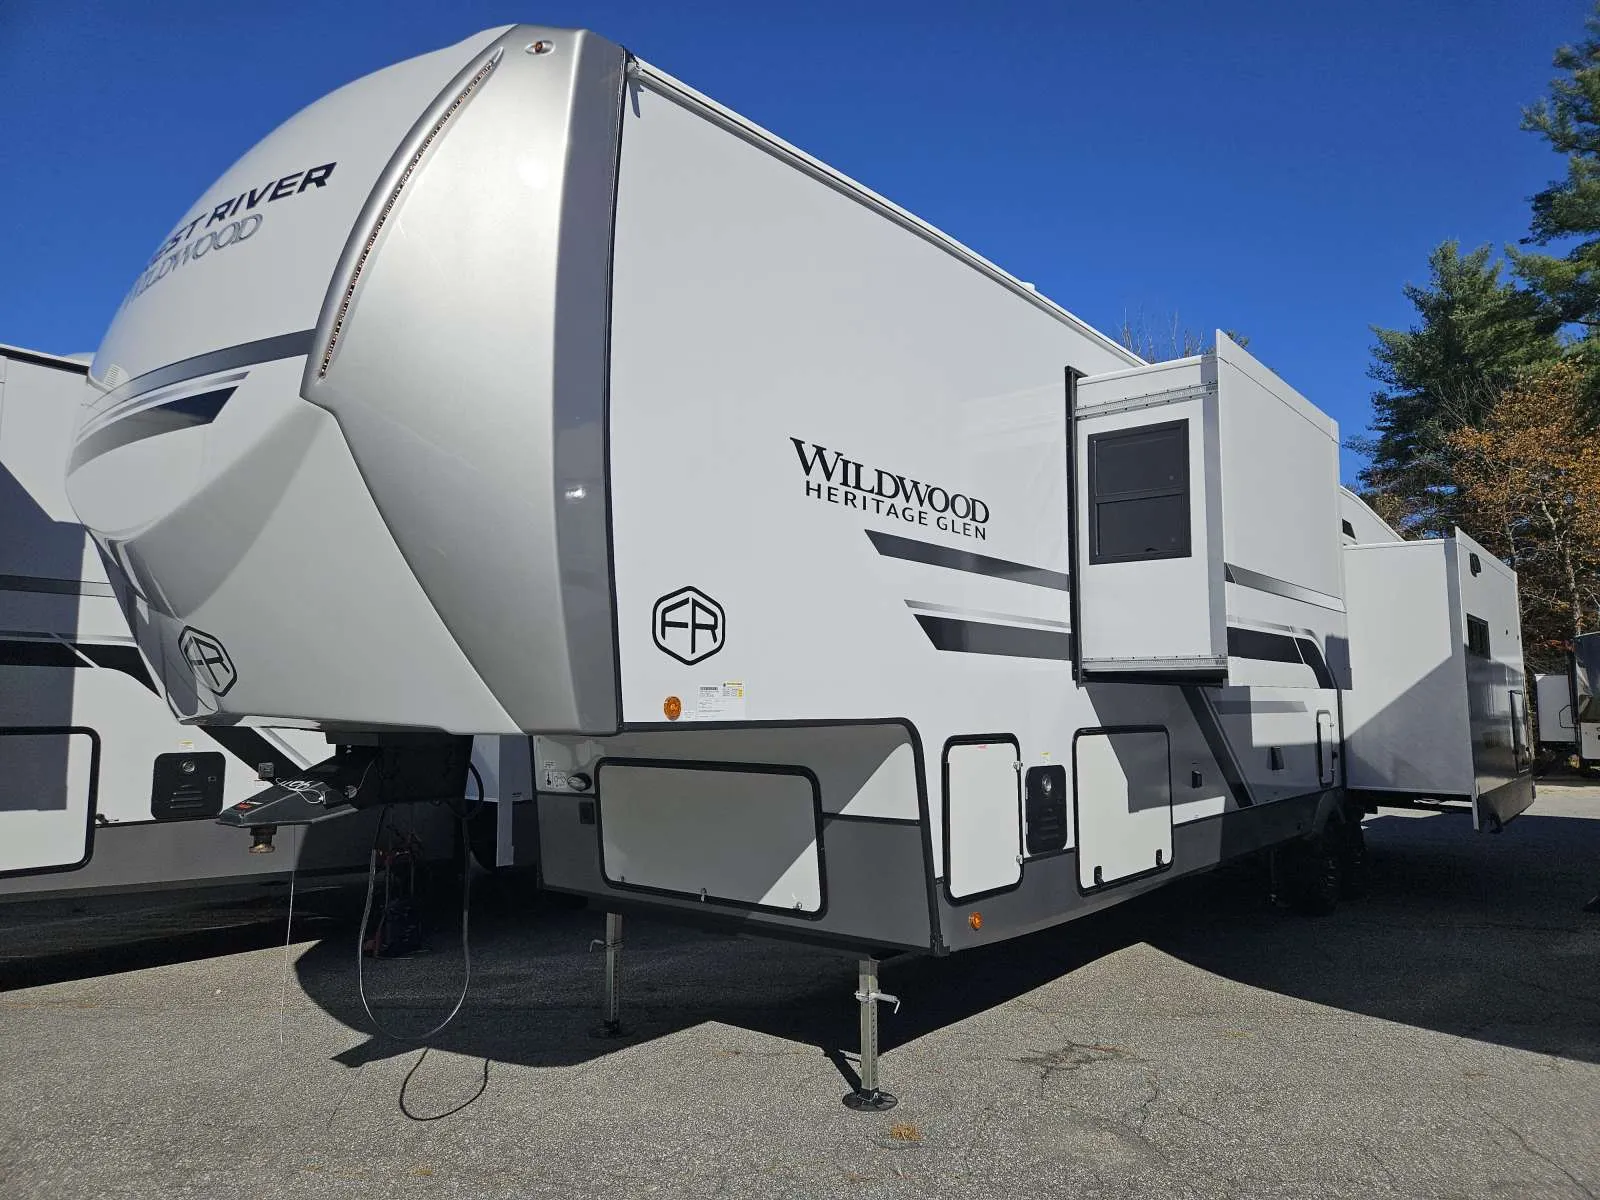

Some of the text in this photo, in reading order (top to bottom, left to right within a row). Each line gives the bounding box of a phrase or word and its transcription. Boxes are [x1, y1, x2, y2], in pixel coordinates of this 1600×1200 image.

[205, 161, 337, 229] RIVER
[789, 436, 990, 524] WILDWOOD
[805, 480, 987, 541] HERITAGE GLEN
